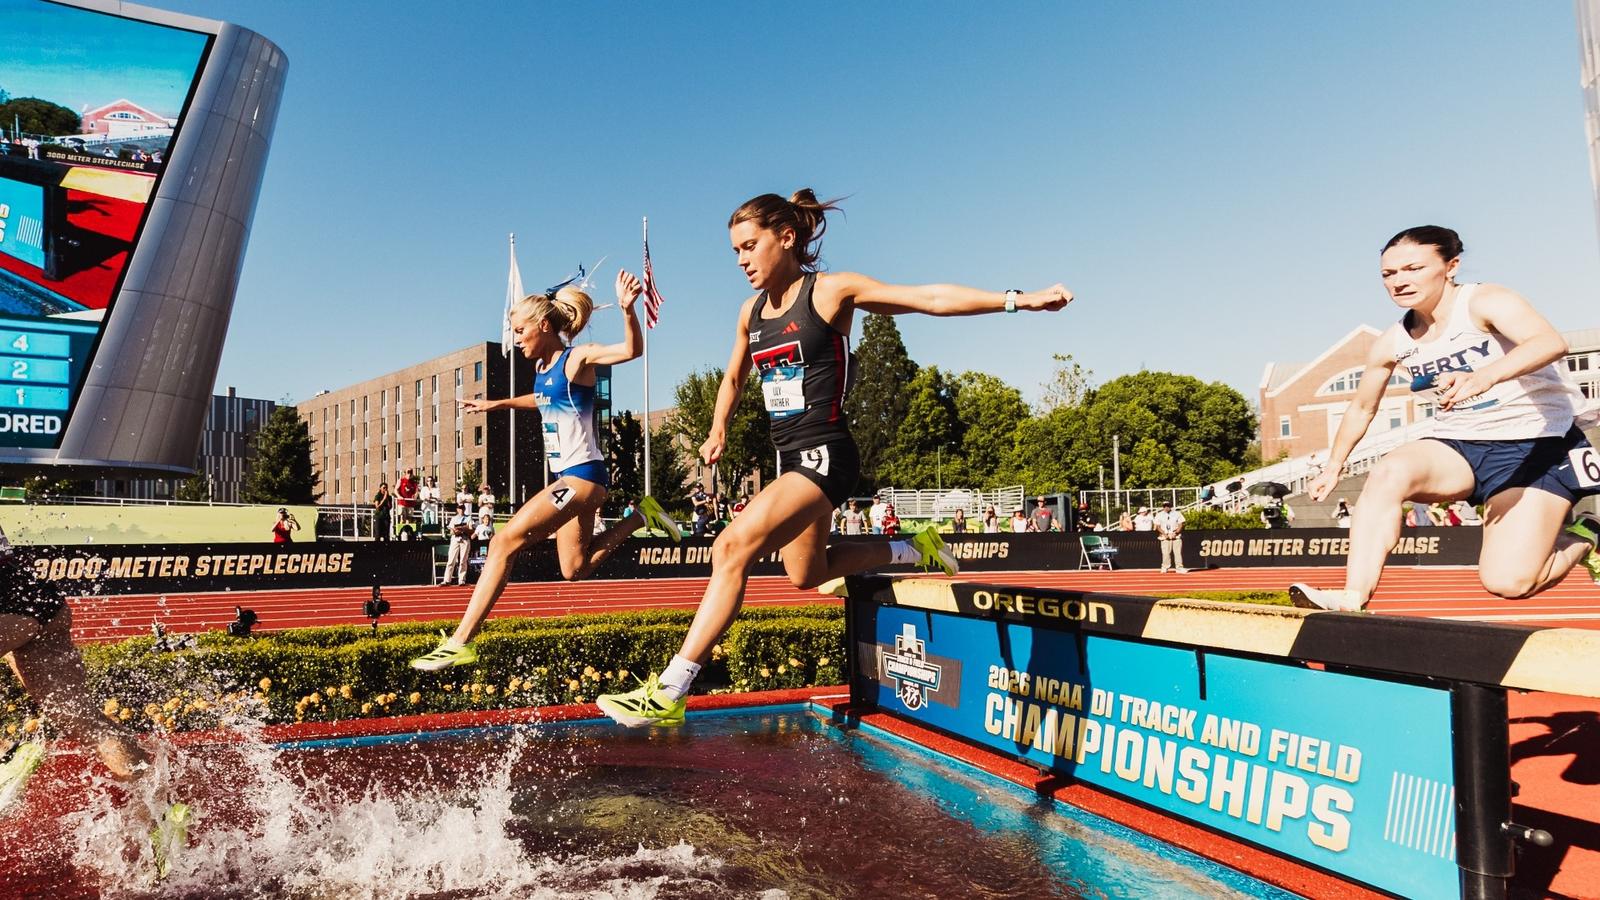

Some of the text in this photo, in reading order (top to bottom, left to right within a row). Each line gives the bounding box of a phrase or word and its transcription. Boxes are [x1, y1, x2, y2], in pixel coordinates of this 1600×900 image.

[47, 151, 145, 169] 3000 METER STEEPLECHASE
[13, 335, 28, 351] 4
[1407, 340, 1490, 376] BERTY
[12, 360, 28, 379] 2
[16, 387, 25, 405] 1
[1582, 450, 1600, 483] 6
[551, 488, 569, 504] 4
[639, 547, 681, 565] NCAA
[1199, 537, 1440, 557] 3000 METER STEEHASE
[34, 553, 354, 580] 3000 METER STEEPLECHASE
[973, 590, 1115, 625] OREGON
[988, 664, 1363, 784] 2026 NCAA DI TRACK AND FIELD
[984, 692, 1356, 853] CHAMPIONSHIPS
